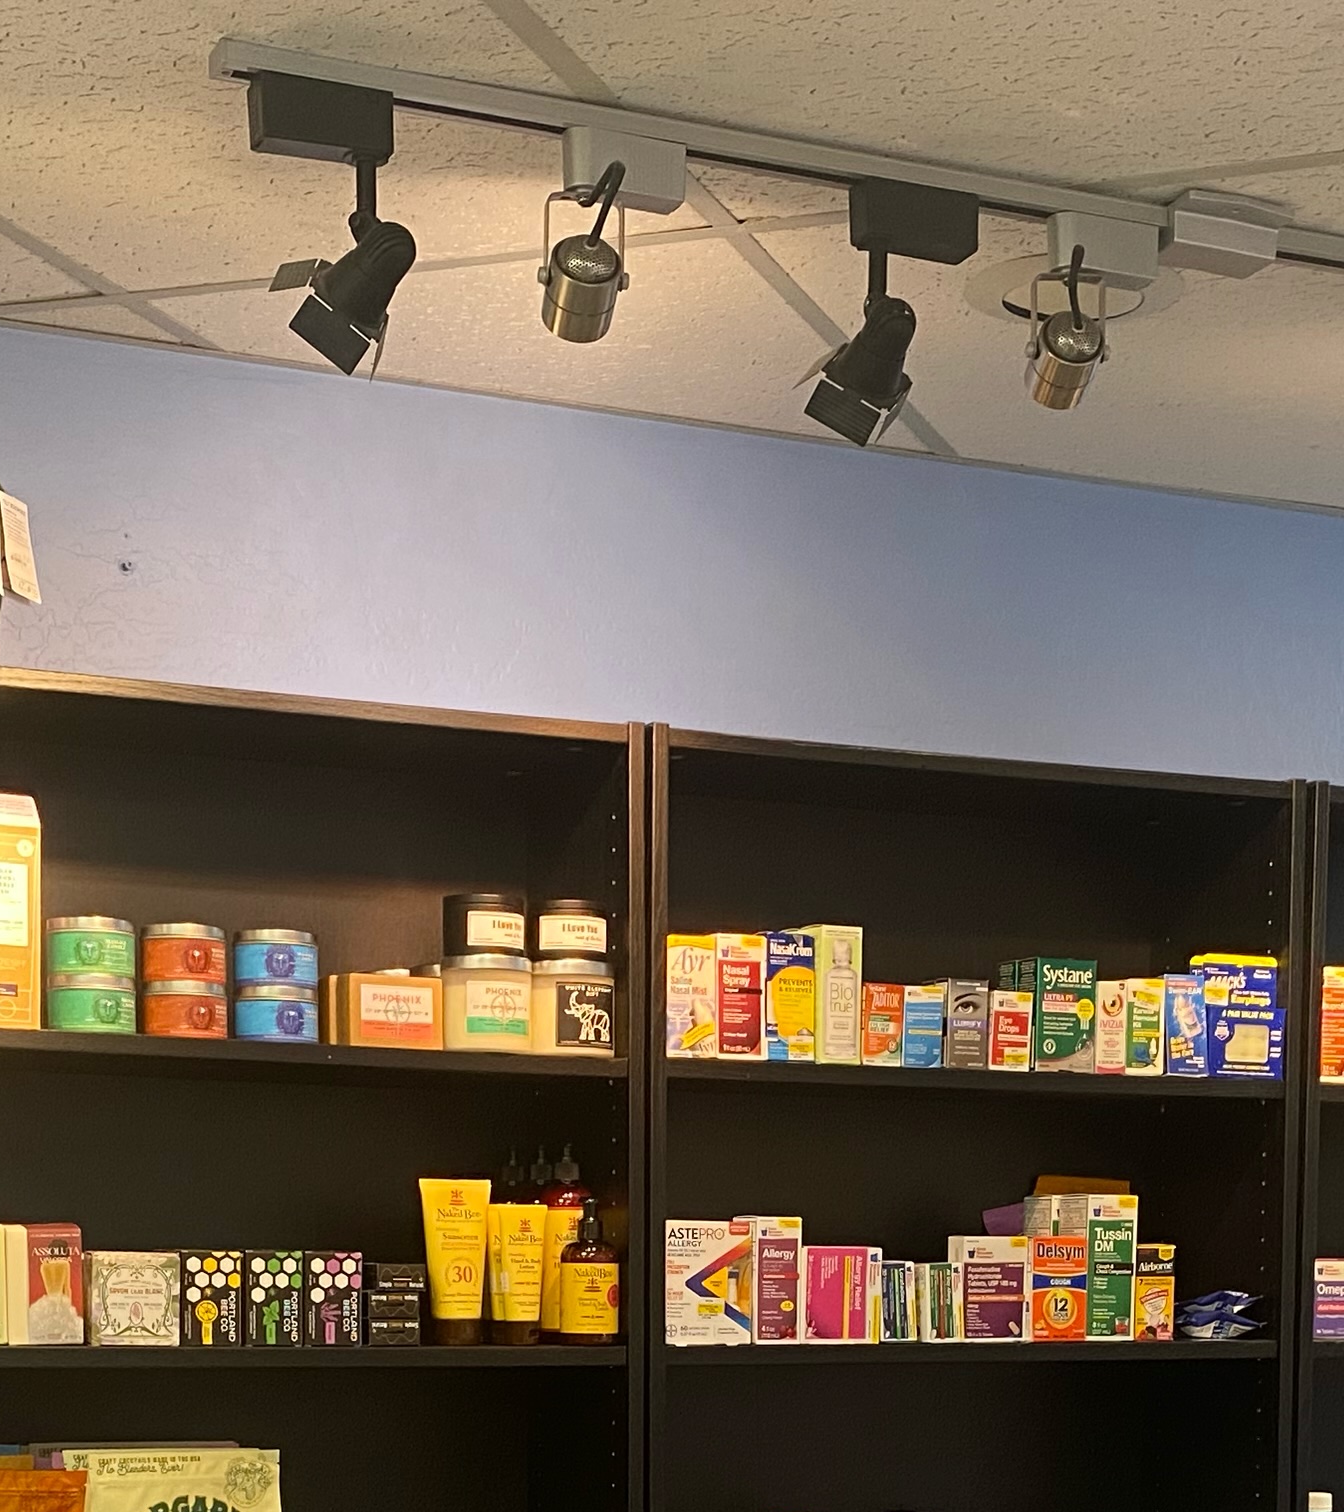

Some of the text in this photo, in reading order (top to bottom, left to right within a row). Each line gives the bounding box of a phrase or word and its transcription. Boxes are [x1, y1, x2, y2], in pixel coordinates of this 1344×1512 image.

[672, 949, 711, 974] Ayr
[723, 965, 749, 975] Nasal
[723, 975, 750, 987] Spray
[1043, 965, 1092, 990] Systane
[485, 987, 522, 996] PHOENIX
[830, 983, 853, 1000] Bio
[372, 993, 422, 1005] PHOENIX
[830, 1001, 852, 1013] true
[668, 1228, 726, 1240] ASTEPRO
[1094, 1228, 1132, 1241] Tussin
[668, 1240, 702, 1248] ALLERGY
[1095, 1240, 1114, 1252] DM
[32, 1247, 80, 1256] ASSOLUTA
[763, 1249, 795, 1259] Allergy
[1037, 1242, 1084, 1260] Delsym
[1139, 1262, 1173, 1272] Airborne
[452, 1266, 473, 1282] 30
[1054, 1298, 1068, 1312] 12
[228, 1291, 236, 1342] PORTLAND
[290, 1291, 299, 1342] PORTLAND
[350, 1291, 358, 1342] PORTLAND
